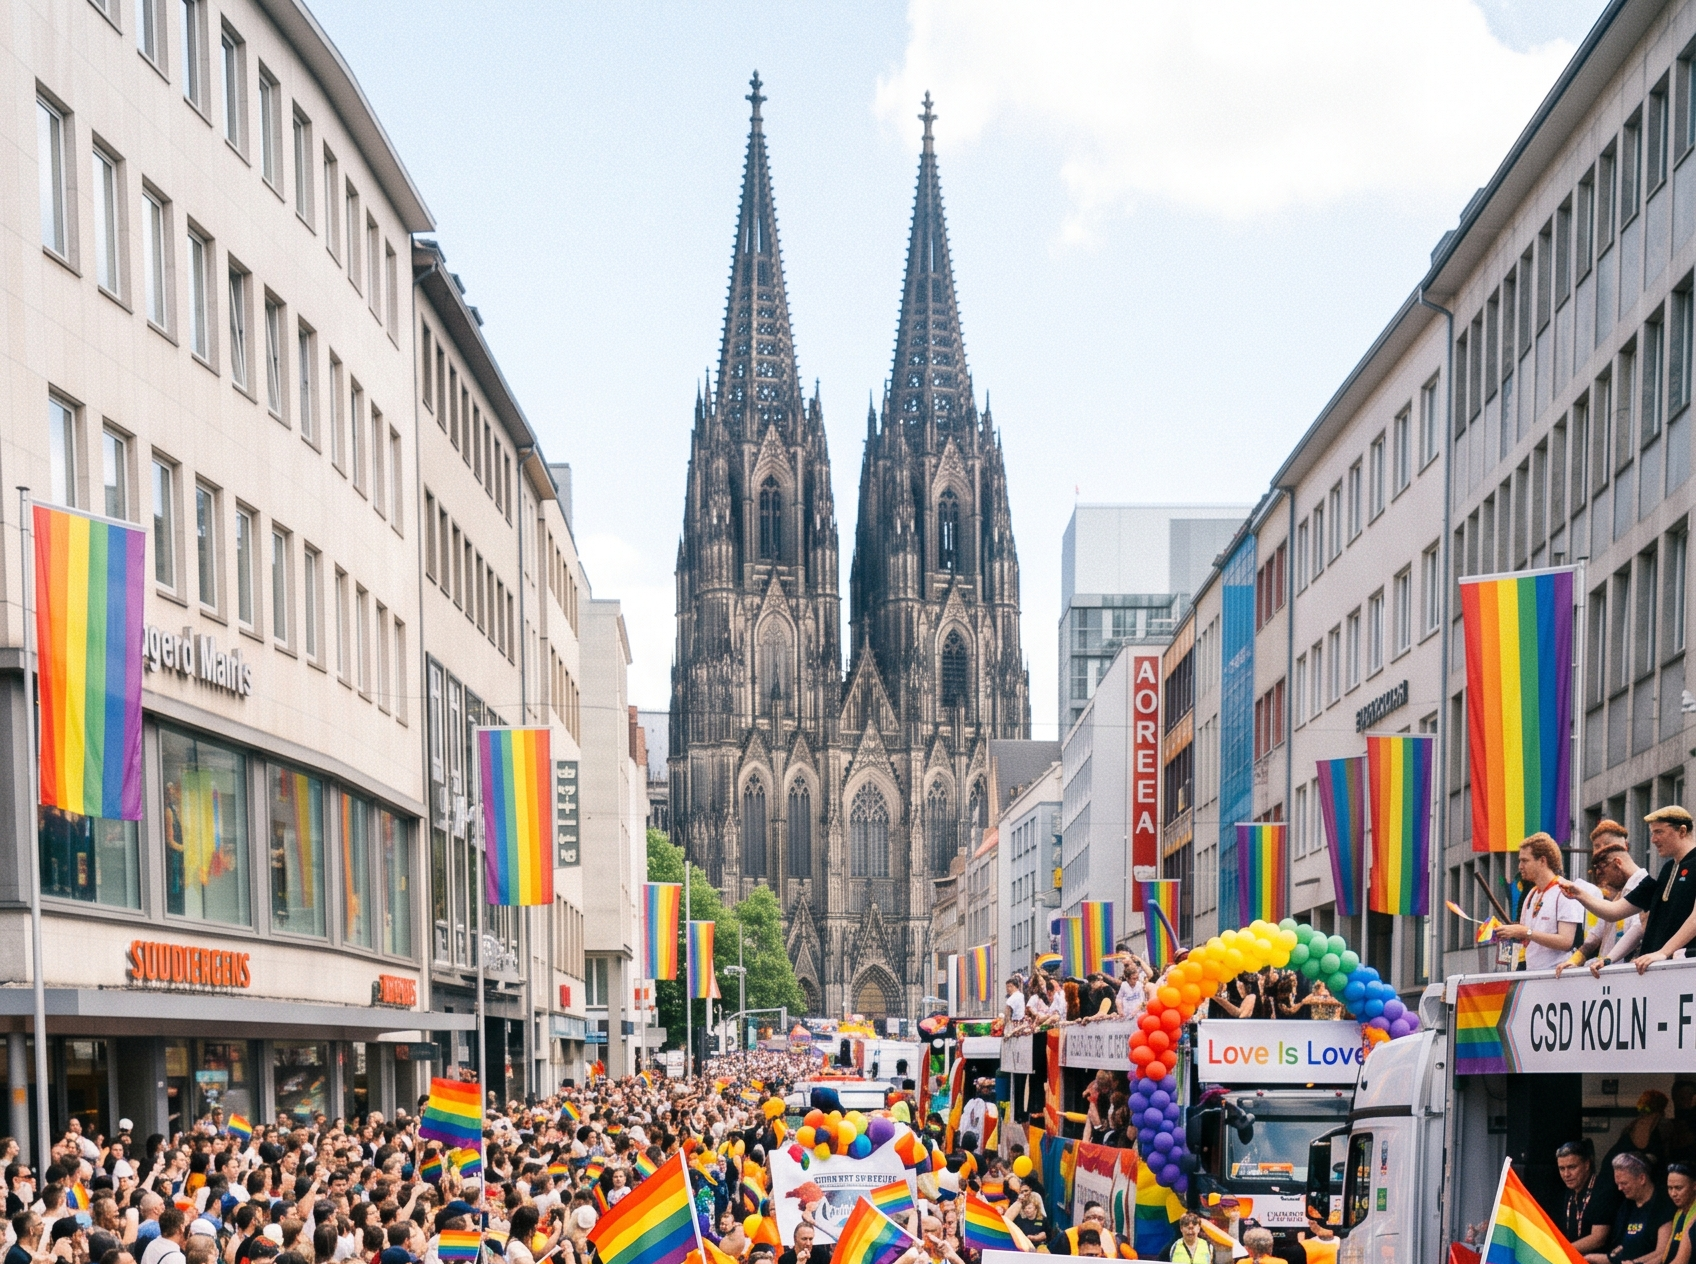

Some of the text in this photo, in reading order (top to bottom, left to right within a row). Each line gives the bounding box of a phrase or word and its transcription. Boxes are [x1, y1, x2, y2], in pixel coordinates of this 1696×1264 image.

[1135, 661, 1158, 834] AOREEA
[1208, 1039, 1364, 1065] Love Is Love
[1530, 1002, 1573, 1052] CSD
[1581, 986, 1647, 1051] KÖLN
[1679, 993, 1696, 1049] F
